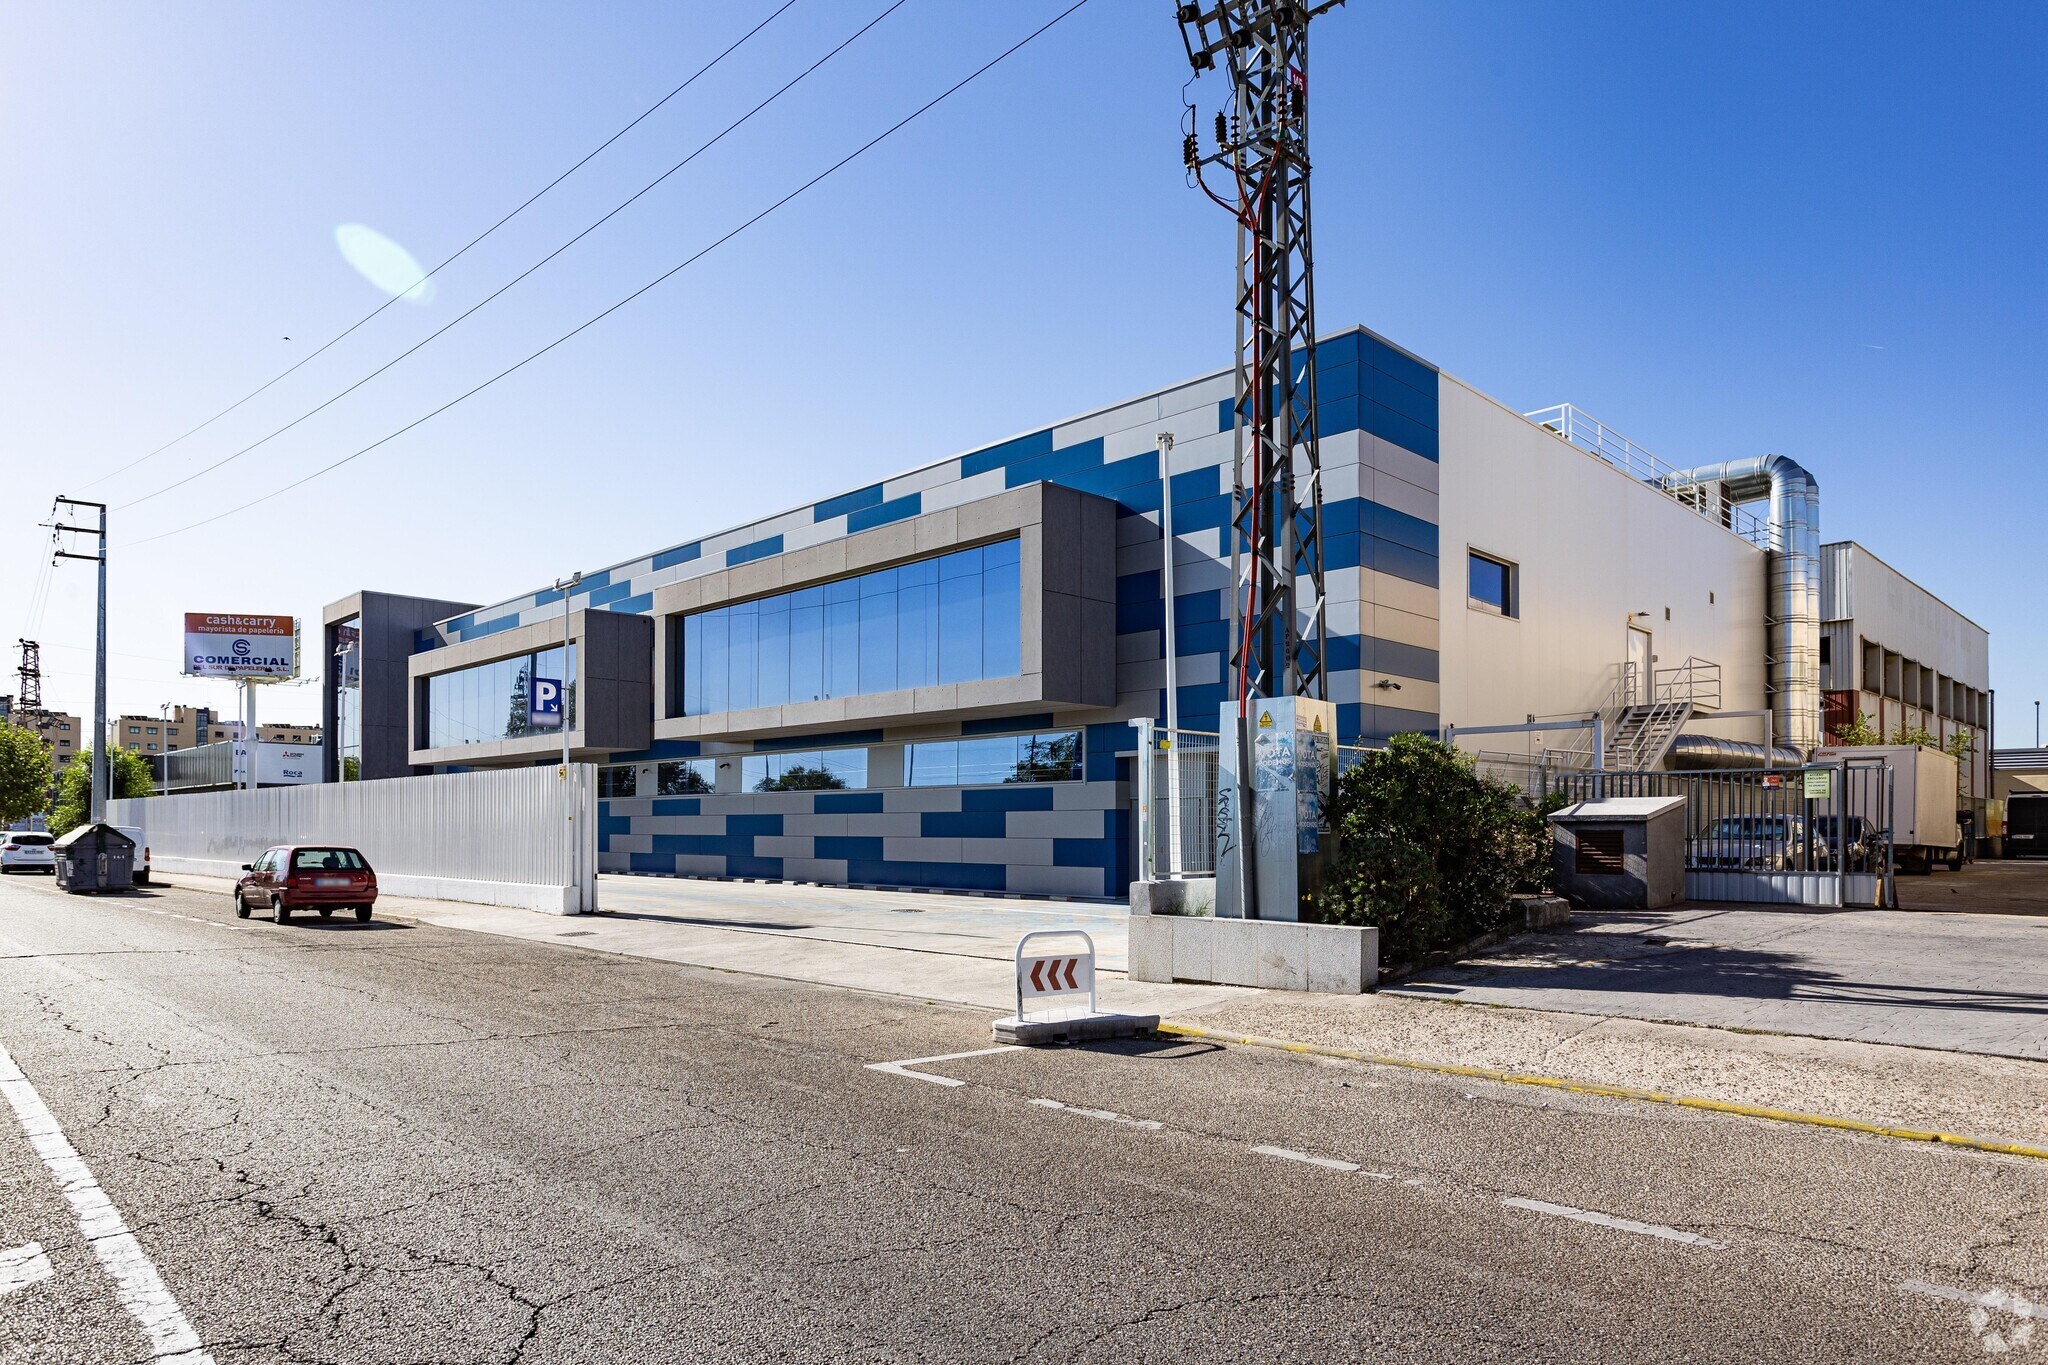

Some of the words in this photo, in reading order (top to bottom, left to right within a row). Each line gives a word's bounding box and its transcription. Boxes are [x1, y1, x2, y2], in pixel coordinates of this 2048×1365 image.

[206, 614, 276, 628] cash&carry
[198, 625, 236, 634] mayorista
[193, 656, 289, 666] COMERCIAL
[536, 681, 557, 711] P
